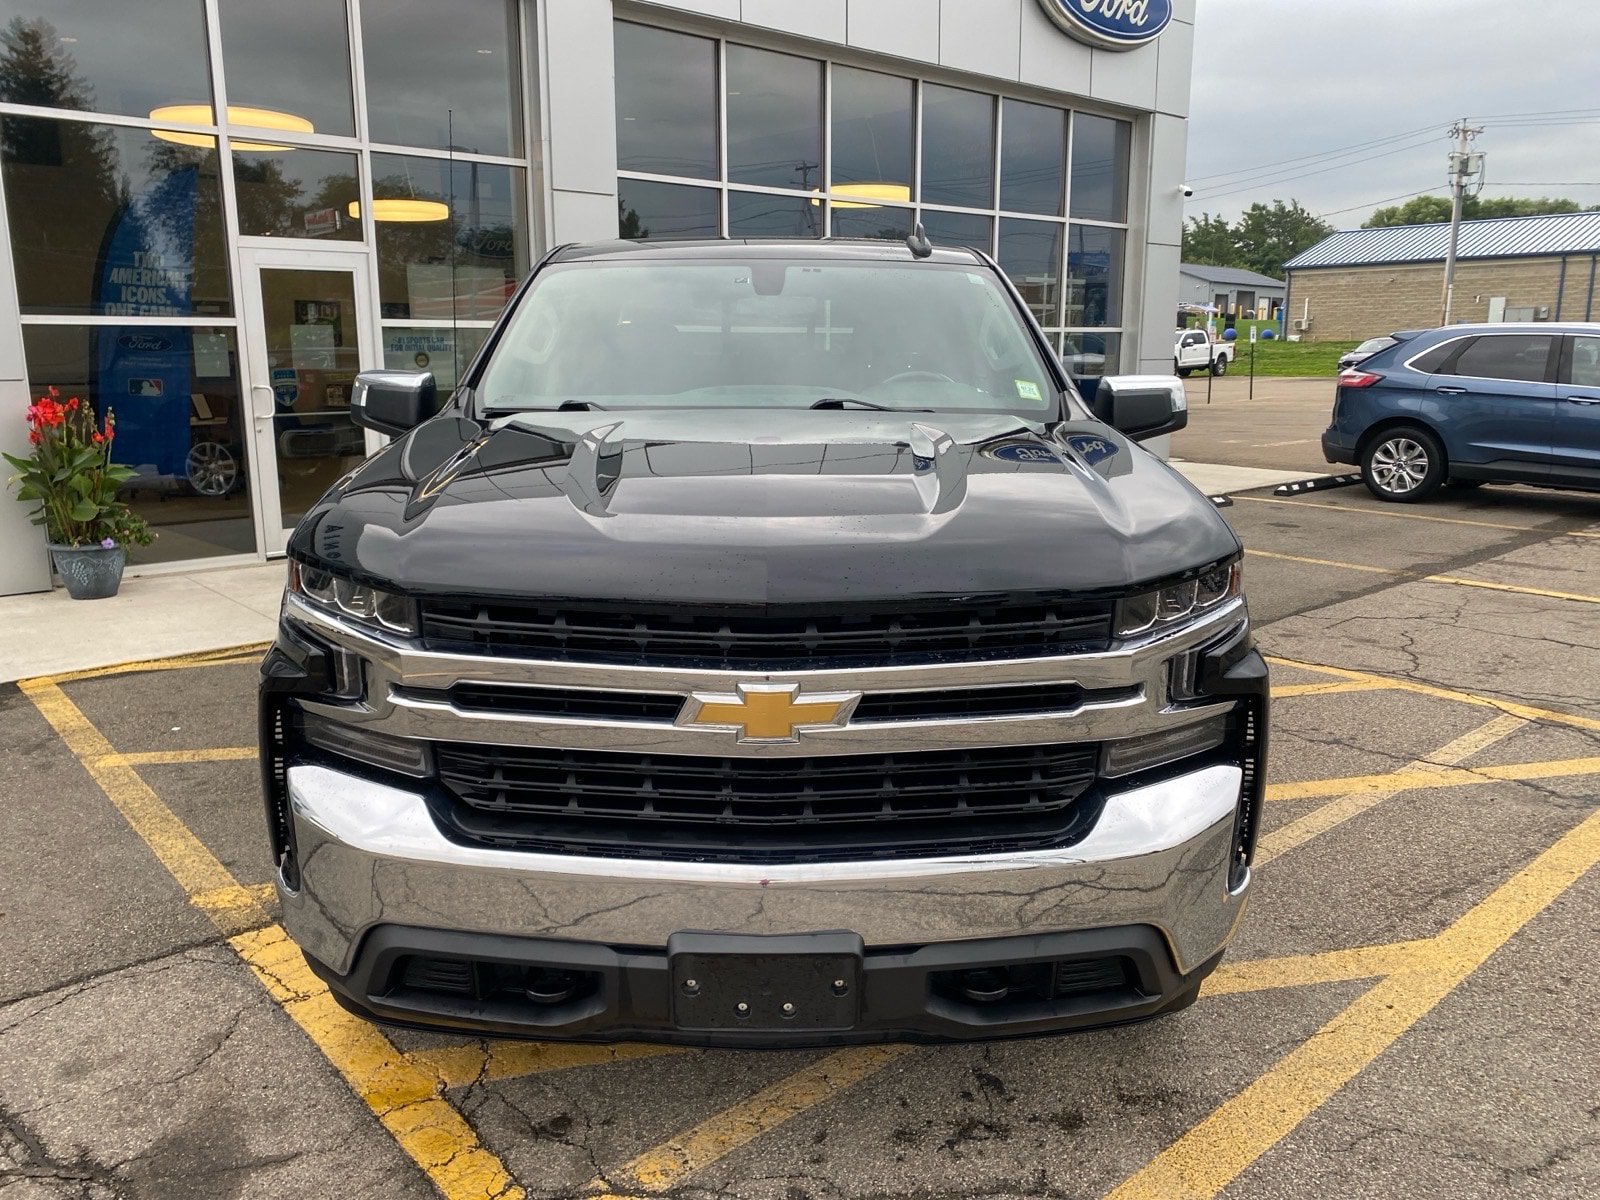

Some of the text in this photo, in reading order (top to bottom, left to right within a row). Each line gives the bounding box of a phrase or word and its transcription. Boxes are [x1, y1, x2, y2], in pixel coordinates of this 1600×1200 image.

[109, 268, 186, 288] AMERICAN
[121, 286, 171, 304] ICONS.
[128, 335, 162, 351] Ford
